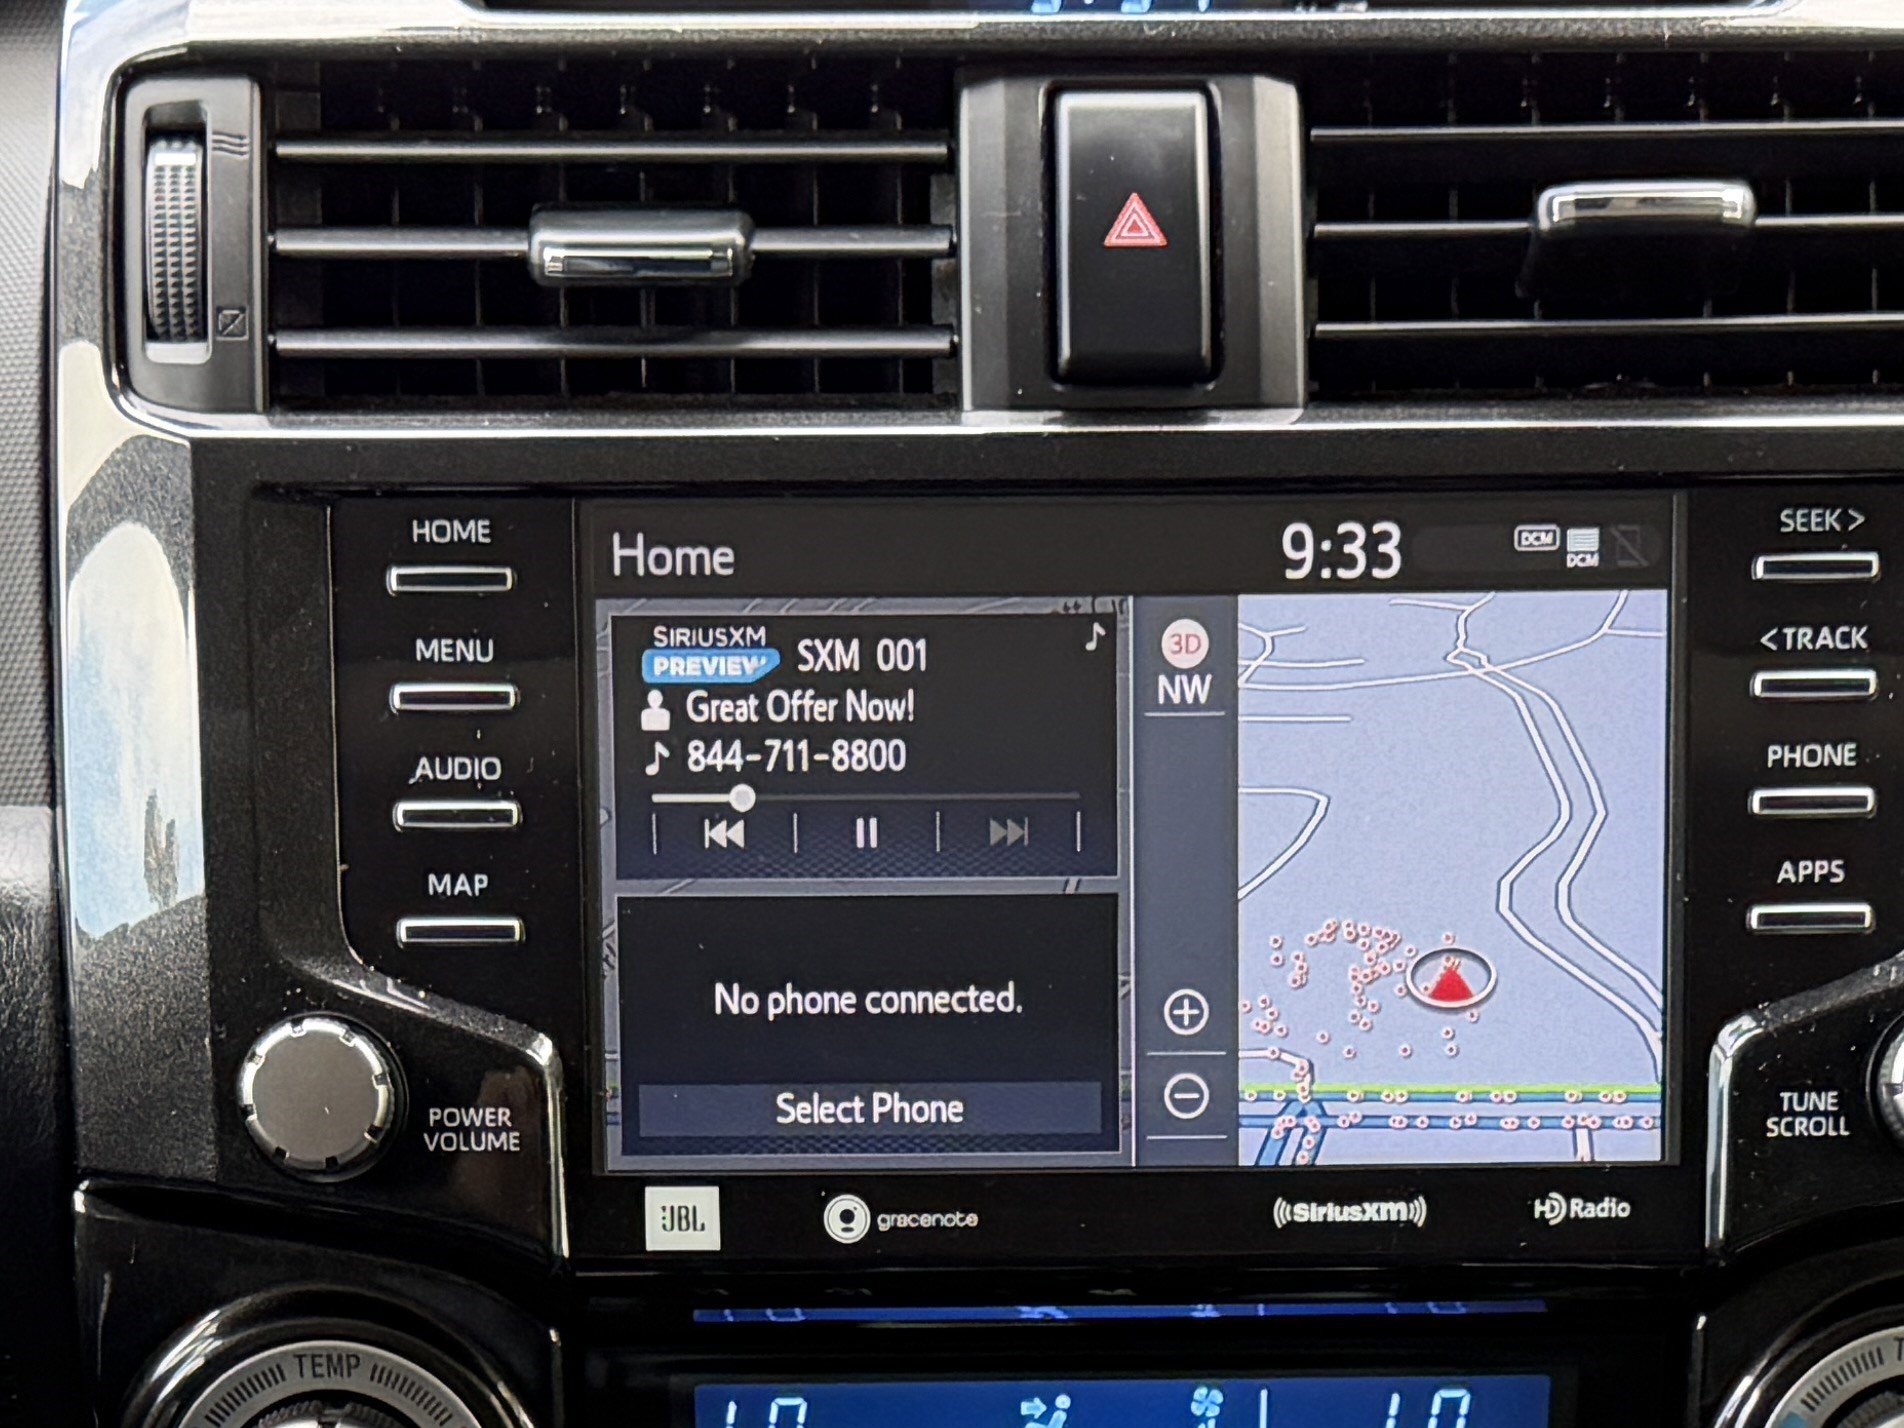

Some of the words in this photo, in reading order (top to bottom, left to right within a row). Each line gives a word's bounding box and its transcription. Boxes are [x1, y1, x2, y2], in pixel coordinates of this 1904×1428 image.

[411, 518, 492, 544] HOME
[1779, 508, 1842, 533] SEEK
[611, 531, 736, 577] Home
[1280, 520, 1403, 580] 9:33
[414, 637, 495, 663] MENU
[1169, 633, 1203, 655] 3D
[1783, 624, 1869, 651] TRACK
[652, 655, 766, 677] PREVIEW
[796, 638, 860, 673] SXM
[876, 637, 928, 672] 001
[1157, 674, 1213, 705] NW
[686, 688, 760, 723] Great
[766, 688, 839, 723] Offer
[845, 687, 916, 723] Now!
[414, 756, 503, 781] AUDIO
[686, 738, 907, 773] 844-711-8800
[1767, 742, 1858, 769] PHONE
[427, 872, 489, 896] MAP
[1776, 858, 1846, 884] APPS
[714, 981, 760, 1016] No
[768, 981, 857, 1022] phone
[865, 980, 1023, 1015] connected.
[775, 1091, 865, 1125] Select
[872, 1091, 964, 1124] Phone
[1779, 1090, 1840, 1113] TUNE
[428, 1107, 513, 1128] POWER
[1765, 1115, 1851, 1138] SCROLL
[422, 1131, 521, 1152] VOLUME
[661, 1204, 707, 1233] JBL
[877, 1208, 979, 1231] gracenote
[1533, 1194, 1568, 1223] HD
[1570, 1197, 1632, 1219] Radio
[293, 1353, 362, 1380] TEMP
